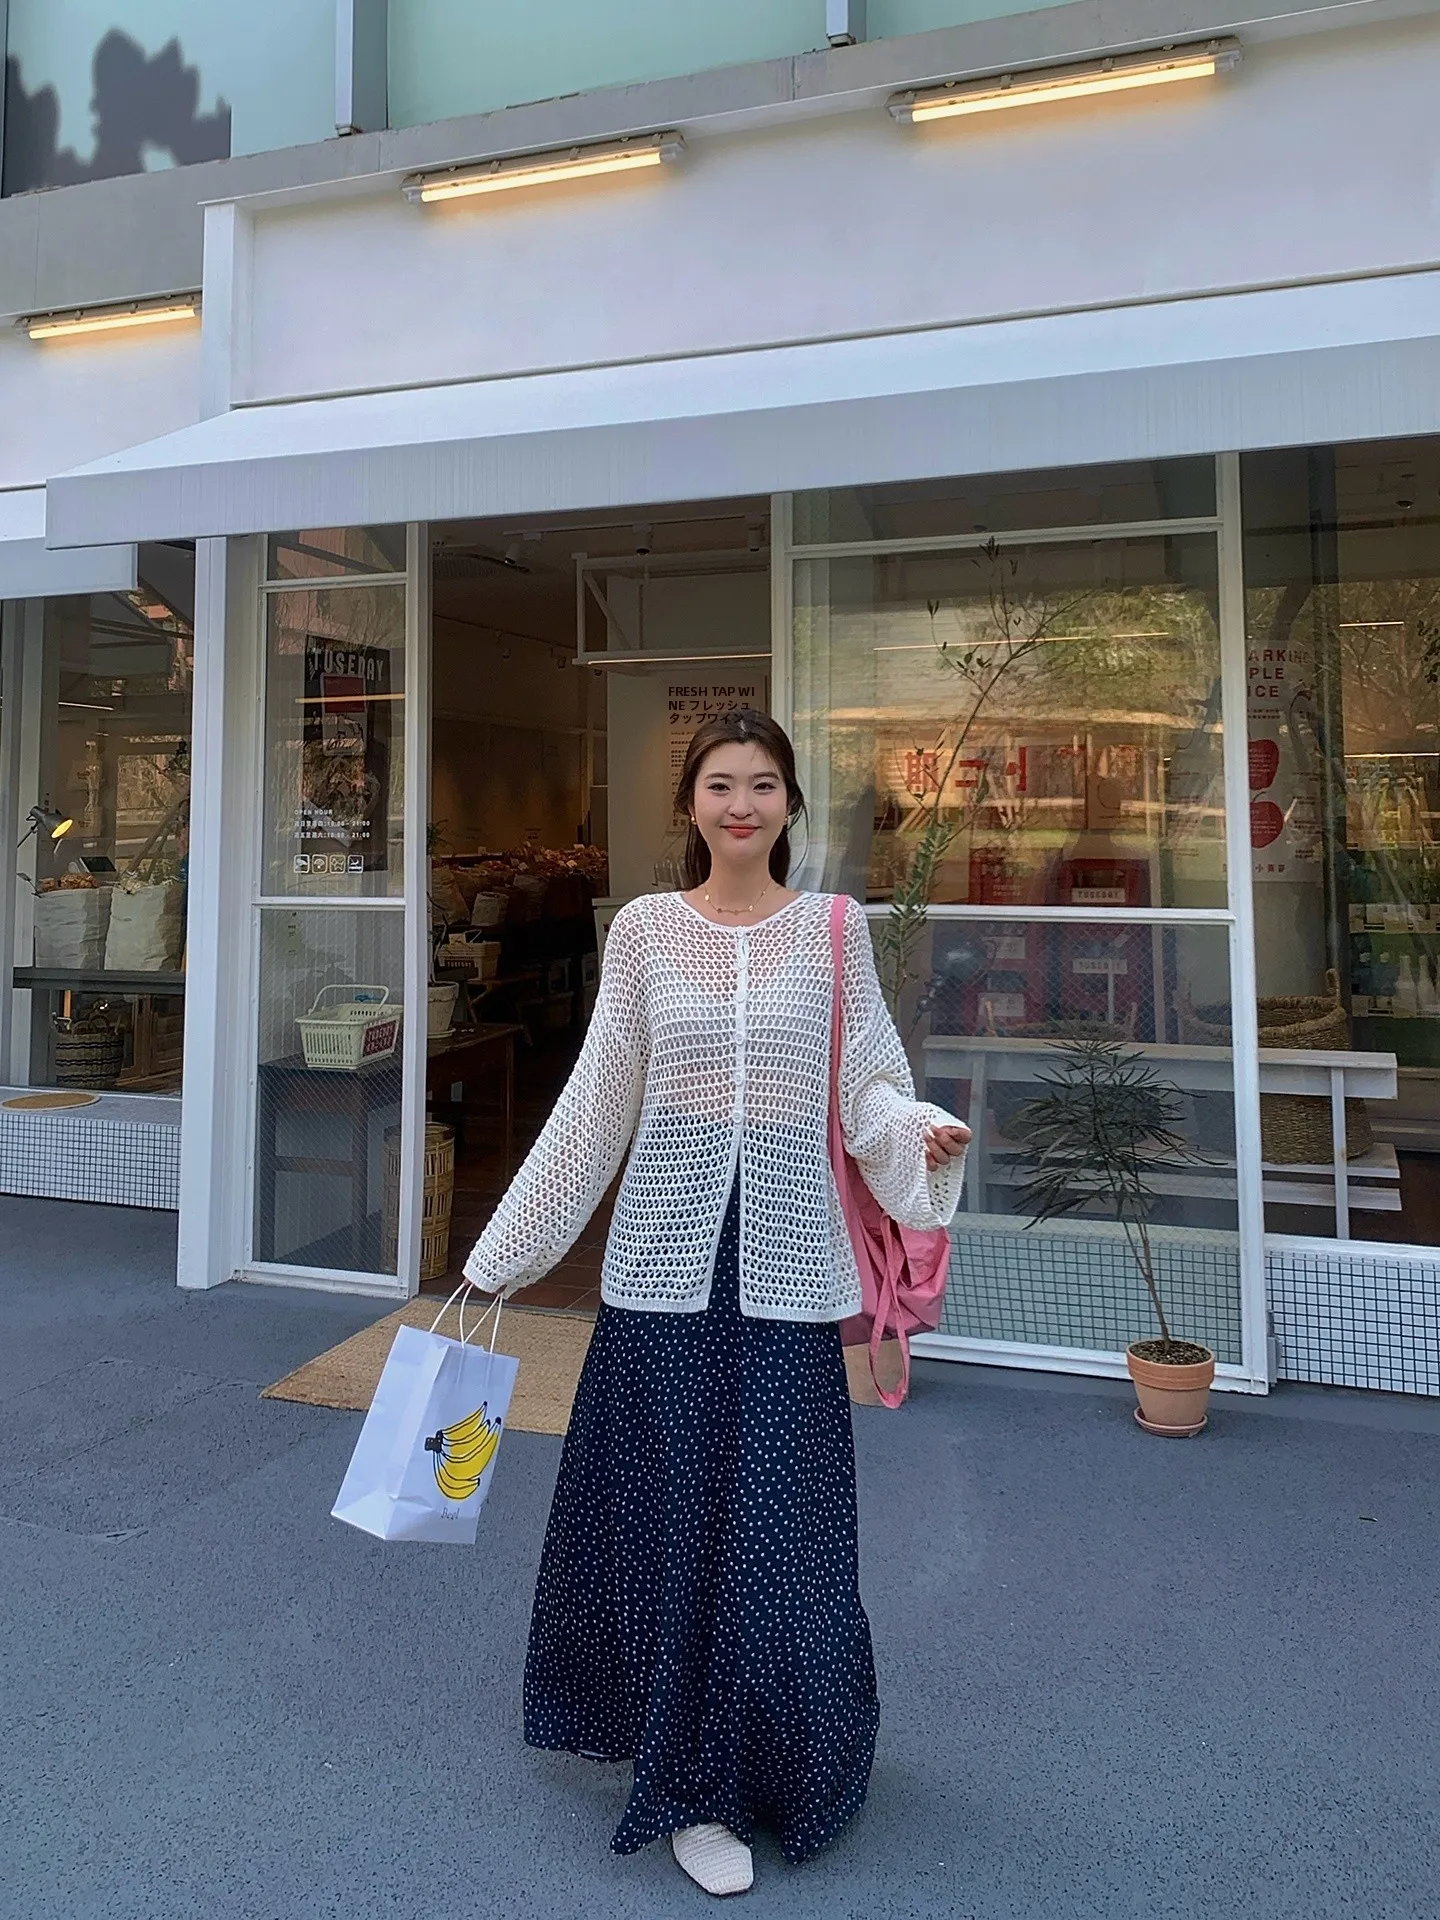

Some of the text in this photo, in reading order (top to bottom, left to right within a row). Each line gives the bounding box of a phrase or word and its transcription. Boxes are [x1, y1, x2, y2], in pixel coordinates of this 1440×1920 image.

[313, 647, 384, 681] TUSEDAY
[668, 686, 755, 697] FRESH TAP WI
[668, 700, 750, 711] NE フレッシュ
